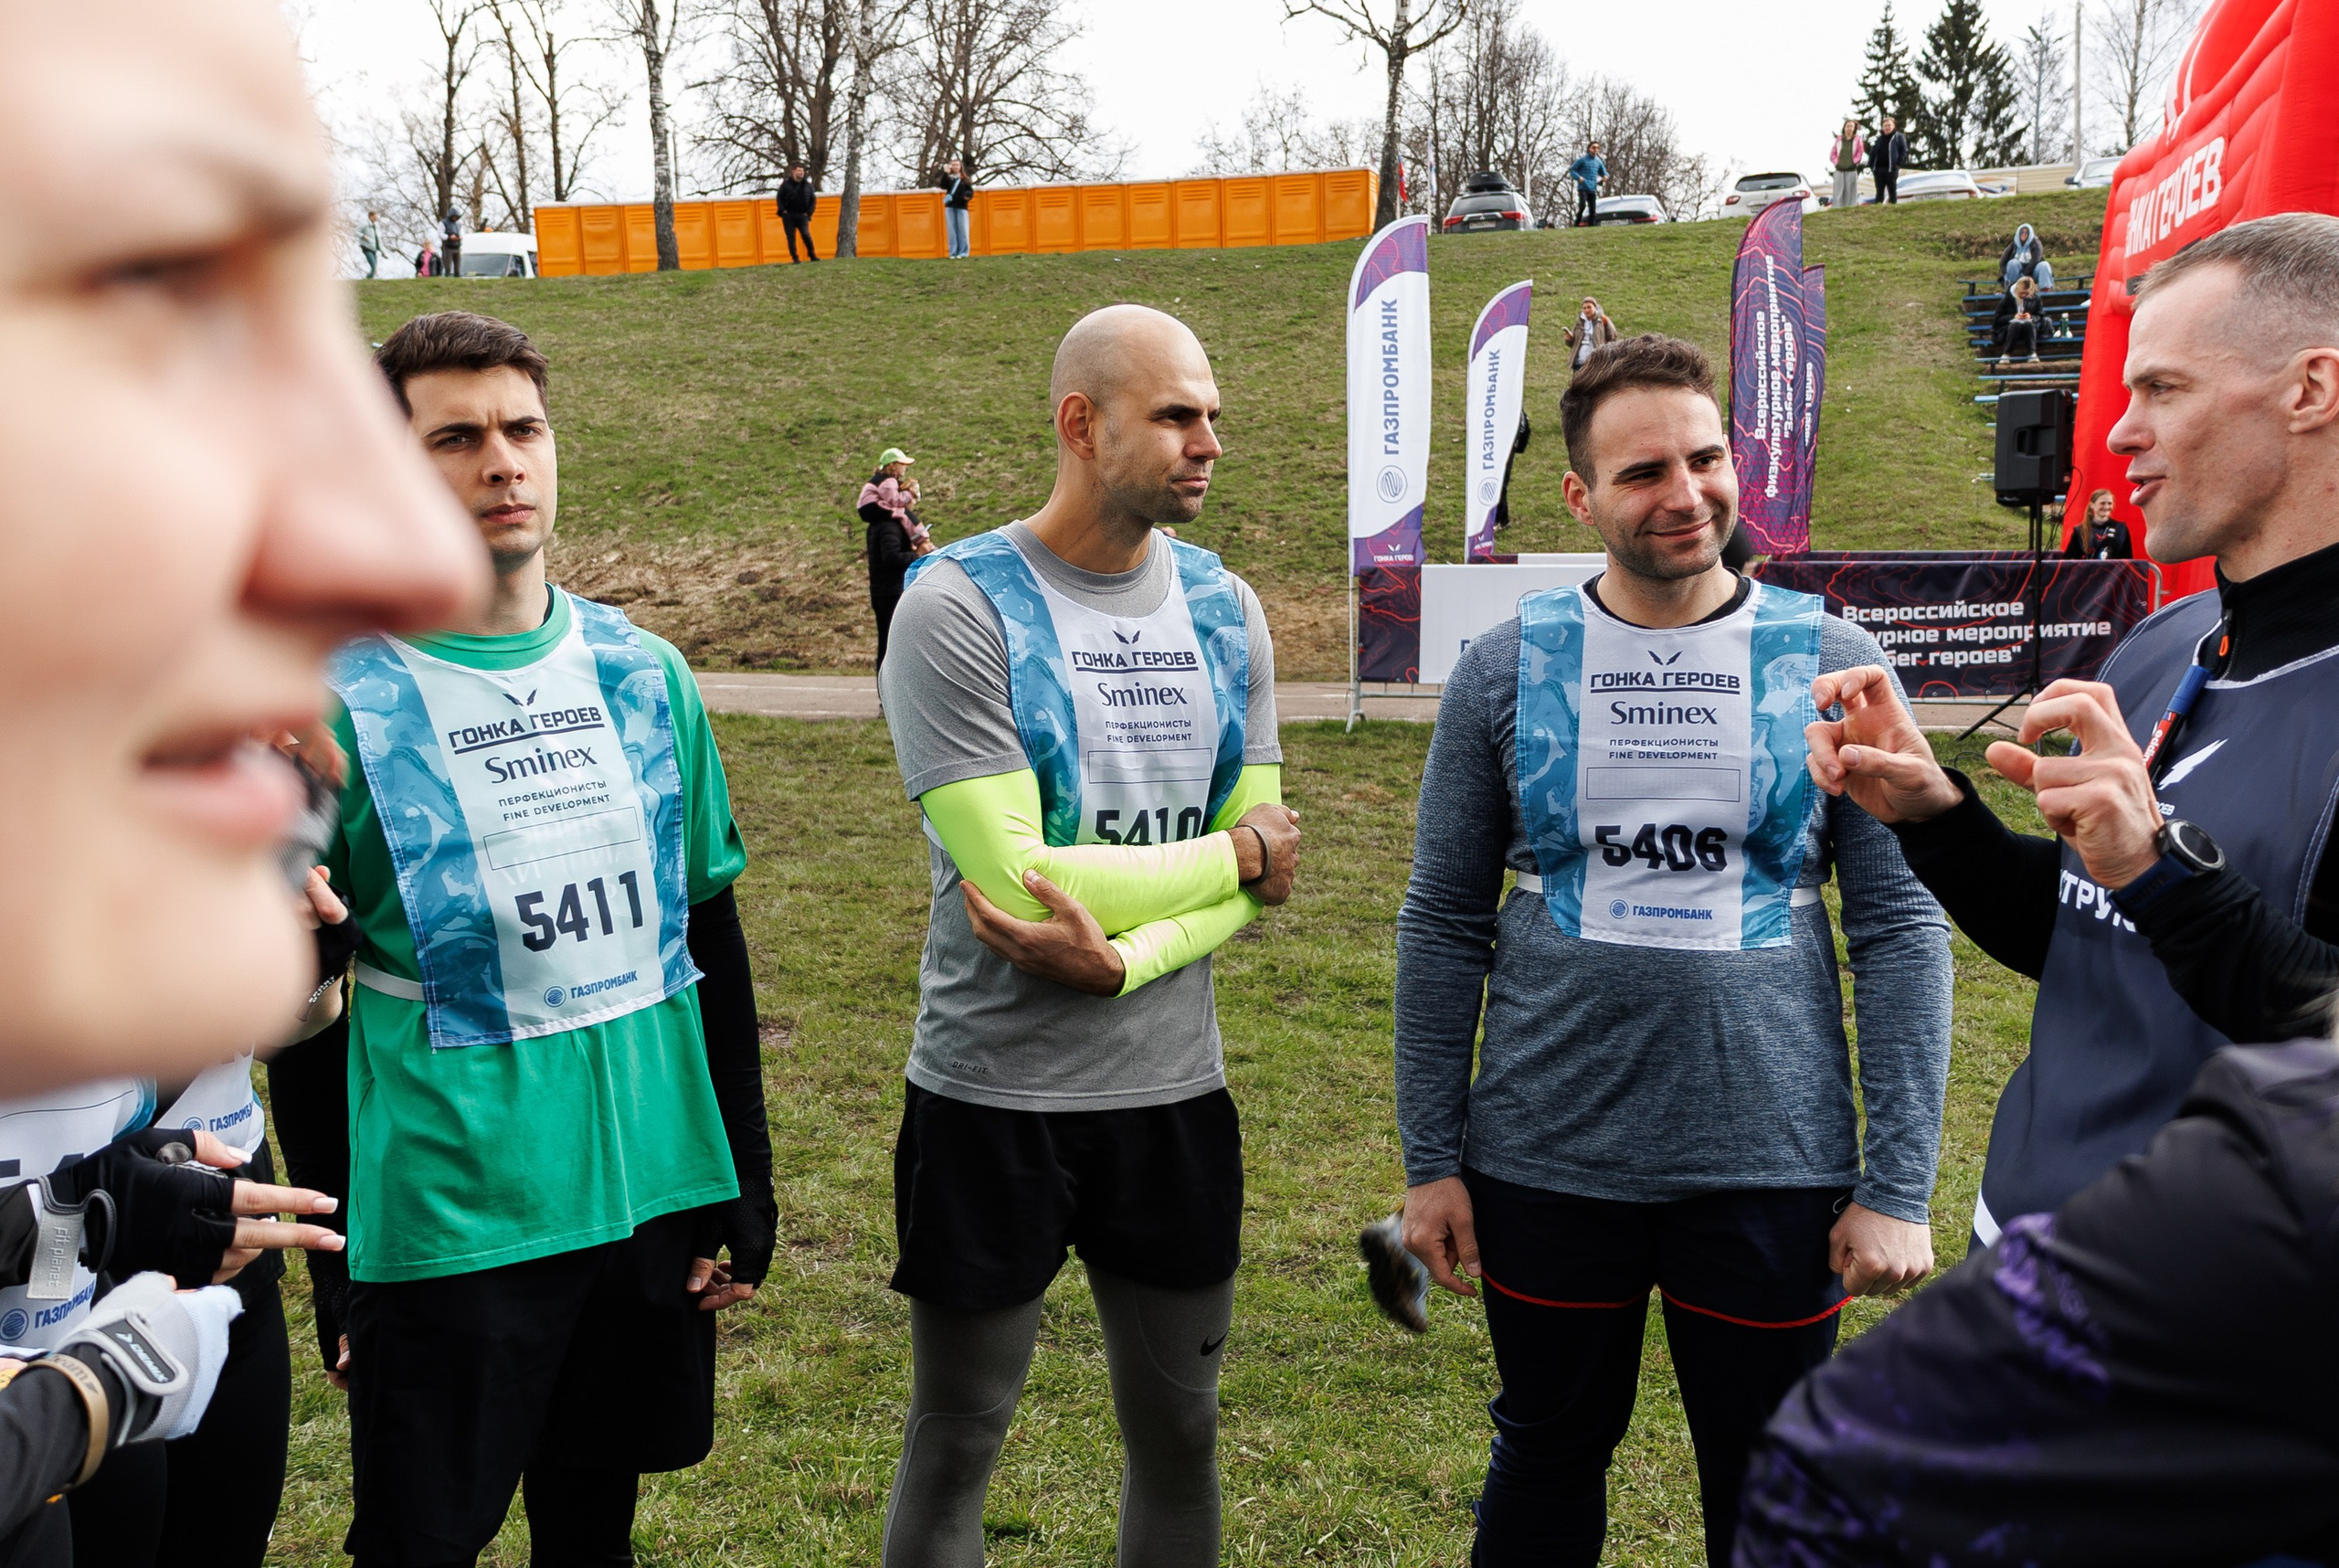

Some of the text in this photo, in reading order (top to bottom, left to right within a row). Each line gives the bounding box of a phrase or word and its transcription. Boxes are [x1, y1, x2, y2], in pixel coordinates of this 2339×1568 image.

[1381, 298, 1399, 455] ГАЗПРОМБАНК
[1754, 311, 1769, 440] Всероссийское
[1764, 255, 1783, 498] физкультурное мероприятие
[1482, 348, 1500, 471] ГАЗПРОМБАНК
[1842, 600, 2024, 624] Всероссийское
[1870, 627, 1940, 647] урное
[1071, 651, 1197, 668] ГОНКА ГЕРОЕВ
[1886, 645, 2022, 669] бег героев"
[1590, 672, 1741, 689] ГОНКА ГЕРОЕВ
[1097, 682, 1188, 707] Sminex
[1105, 719, 1192, 730] ПЕРФЕКЦИОНИСТЫ
[1609, 701, 1719, 726] Sminex
[448, 706, 603, 748] ГОНКА ГЕРОЕВ
[1106, 733, 1192, 744] FINE DEVELOPMENT
[1609, 737, 1719, 747] ПЕРФЕКЦИОНИСТЫ
[484, 747, 598, 784] Sminex
[1609, 751, 1719, 760] FINE DEVELOPMENT
[498, 780, 607, 807] ПЕРФЕКЦИОНИСТЫ
[503, 794, 611, 822] FINE DEVELOPMENT
[1092, 806, 1202, 846] 5410
[1594, 822, 1729, 873] 5406
[514, 870, 644, 953] 5411
[1632, 905, 1713, 920] ГАЗПРОМБАНК
[570, 969, 638, 1000] ГАЗПРОМБАНК
[951, 1061, 989, 1075] DRI-FIT
